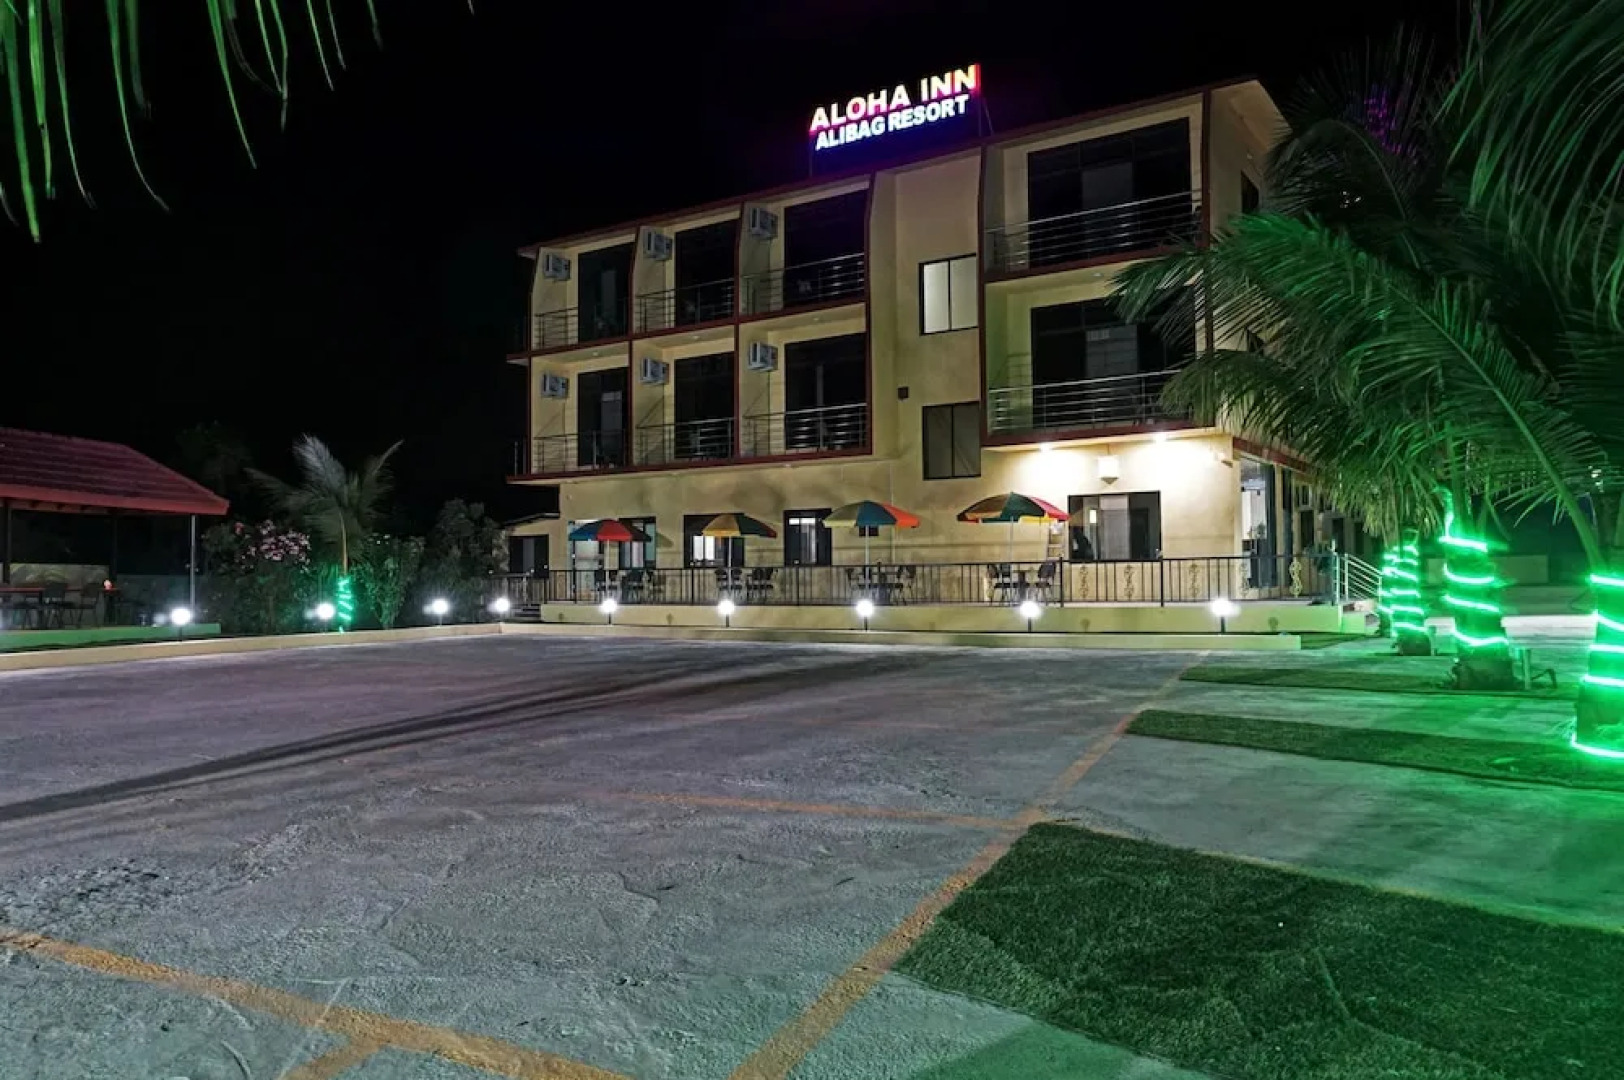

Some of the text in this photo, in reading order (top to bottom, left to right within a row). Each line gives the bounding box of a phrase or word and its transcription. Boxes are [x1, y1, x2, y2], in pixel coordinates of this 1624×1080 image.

[810, 64, 979, 132] ALOHA INN
[815, 94, 969, 150] ALIBAG RESORT
